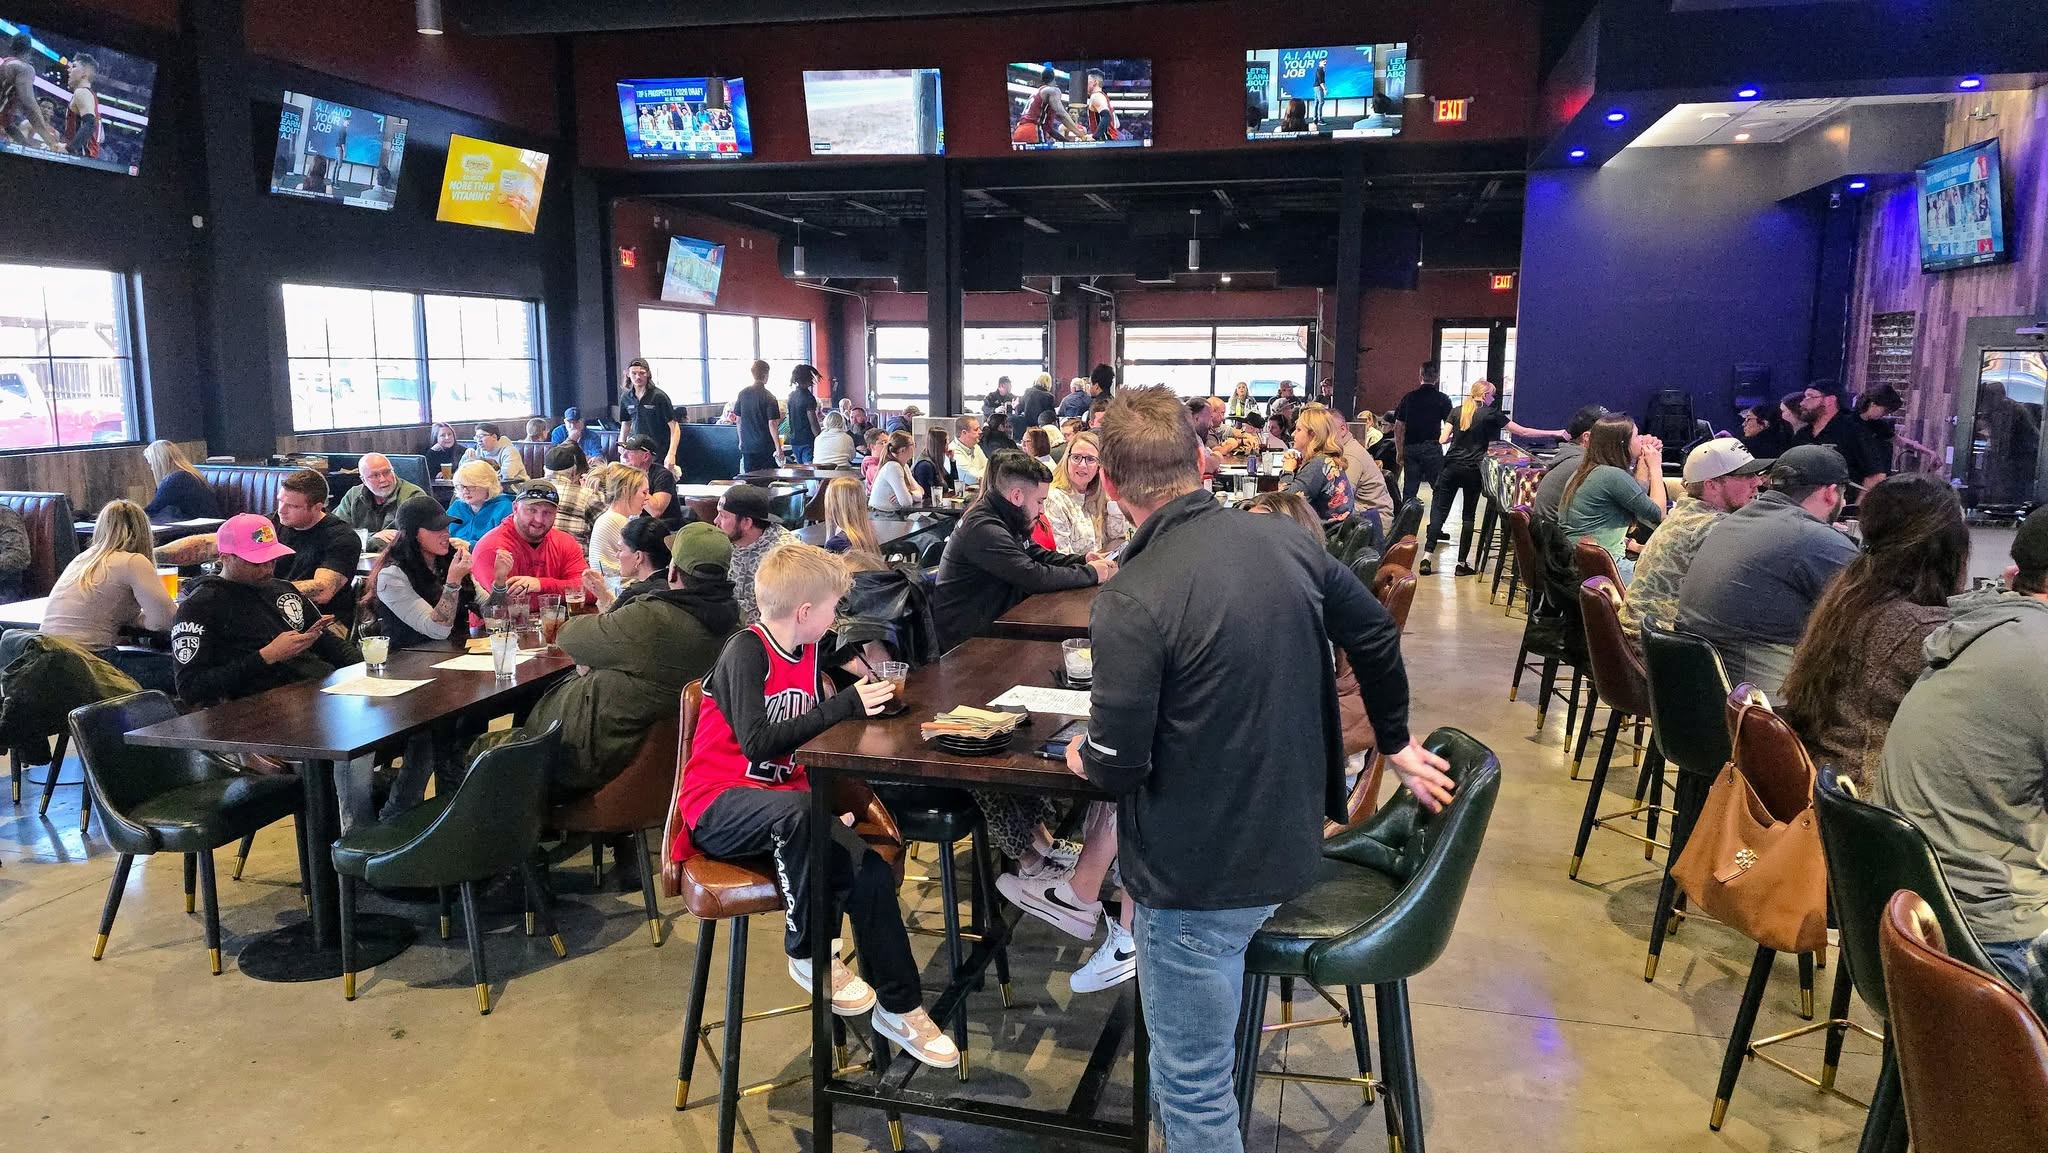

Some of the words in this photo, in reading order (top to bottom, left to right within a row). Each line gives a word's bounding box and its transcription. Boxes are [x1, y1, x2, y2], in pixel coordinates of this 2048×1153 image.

[1303, 50, 1328, 60] AND
[1284, 59, 1315, 70] YOUR
[1283, 68, 1306, 79] JOB
[332, 107, 352, 118] AND
[1438, 99, 1464, 121] EXIT
[314, 112, 341, 126] YOUR
[312, 122, 332, 134] JOB
[449, 181, 473, 191] MORE
[474, 182, 495, 191] THAN
[451, 191, 482, 201] VITAMIN
[1494, 275, 1511, 288] EXIT
[174, 638, 198, 650] NETS
